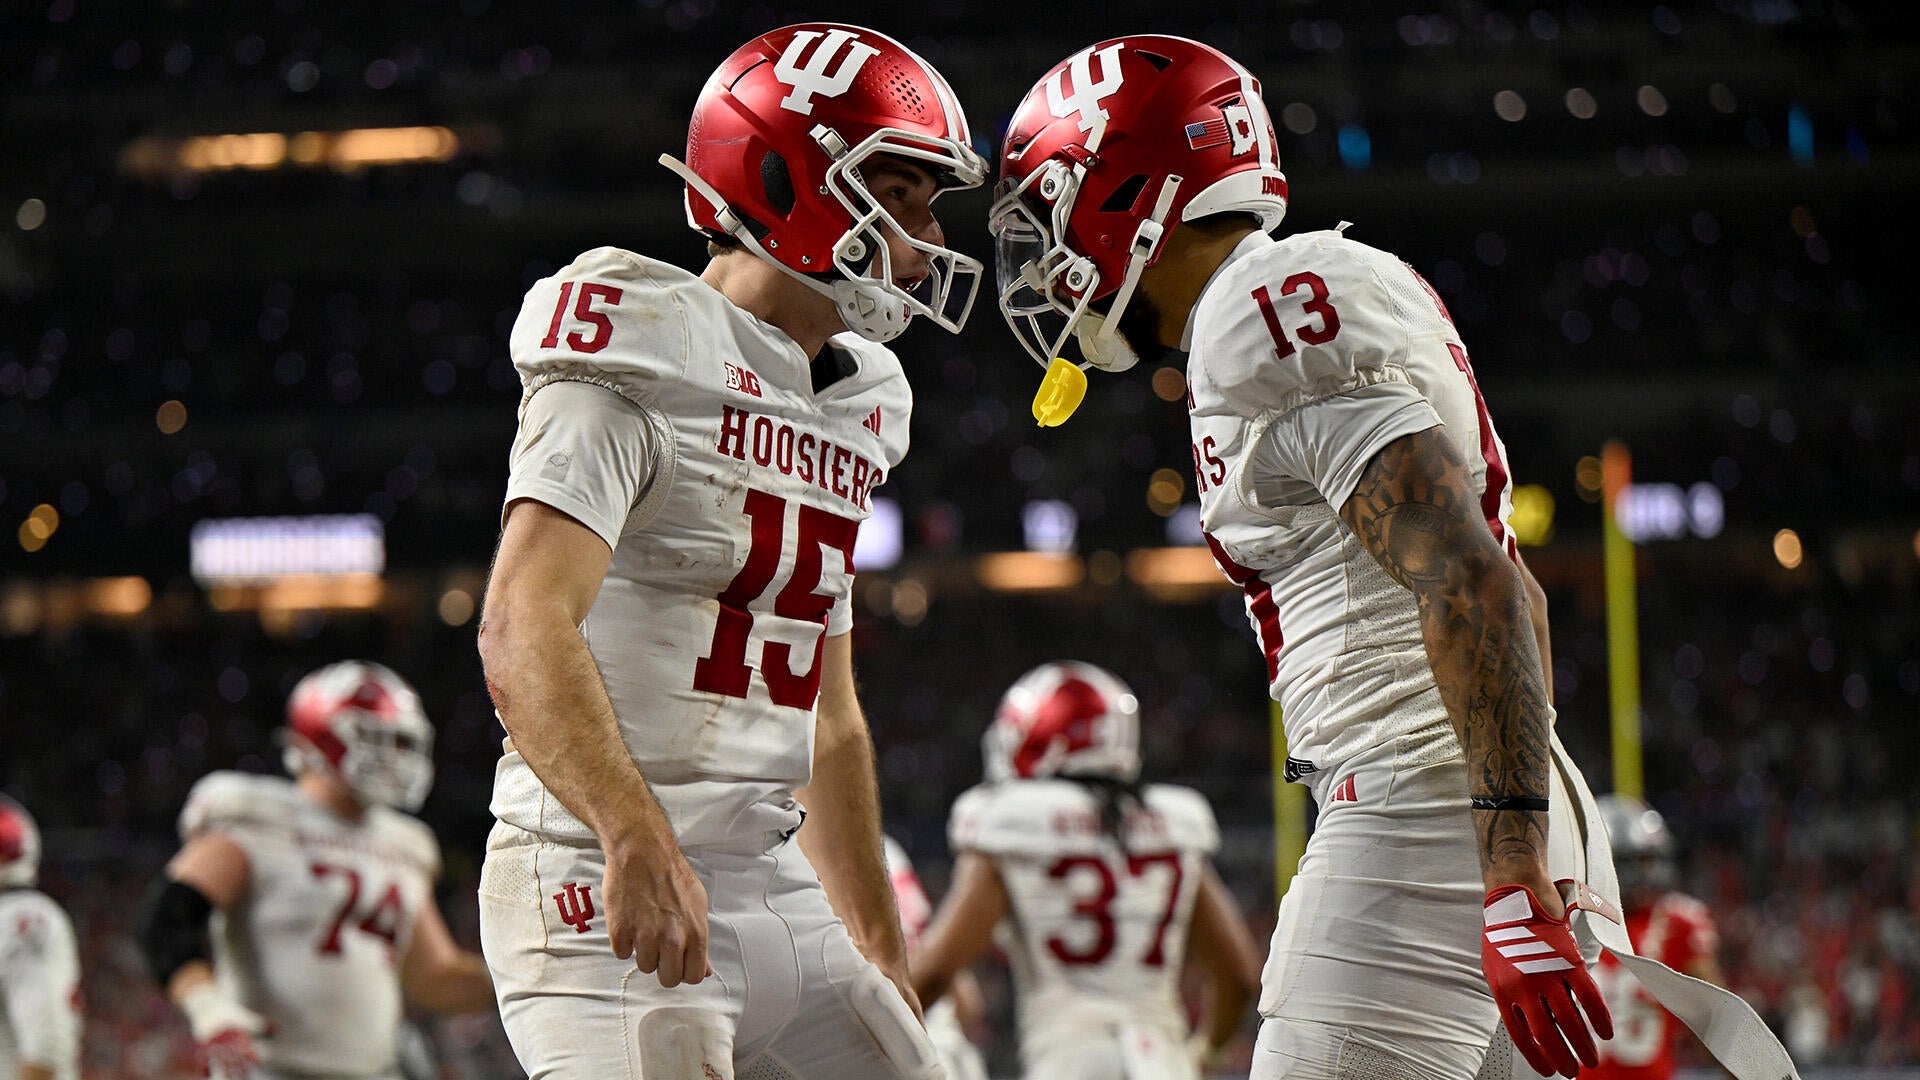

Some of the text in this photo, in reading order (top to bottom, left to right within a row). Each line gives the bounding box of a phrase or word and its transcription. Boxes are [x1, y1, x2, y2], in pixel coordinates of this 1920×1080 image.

[540, 281, 623, 354] 15
[1251, 271, 1340, 360] 13
[693, 487, 860, 712] 15
[308, 861, 402, 972] 74
[1045, 850, 1183, 968] 37
